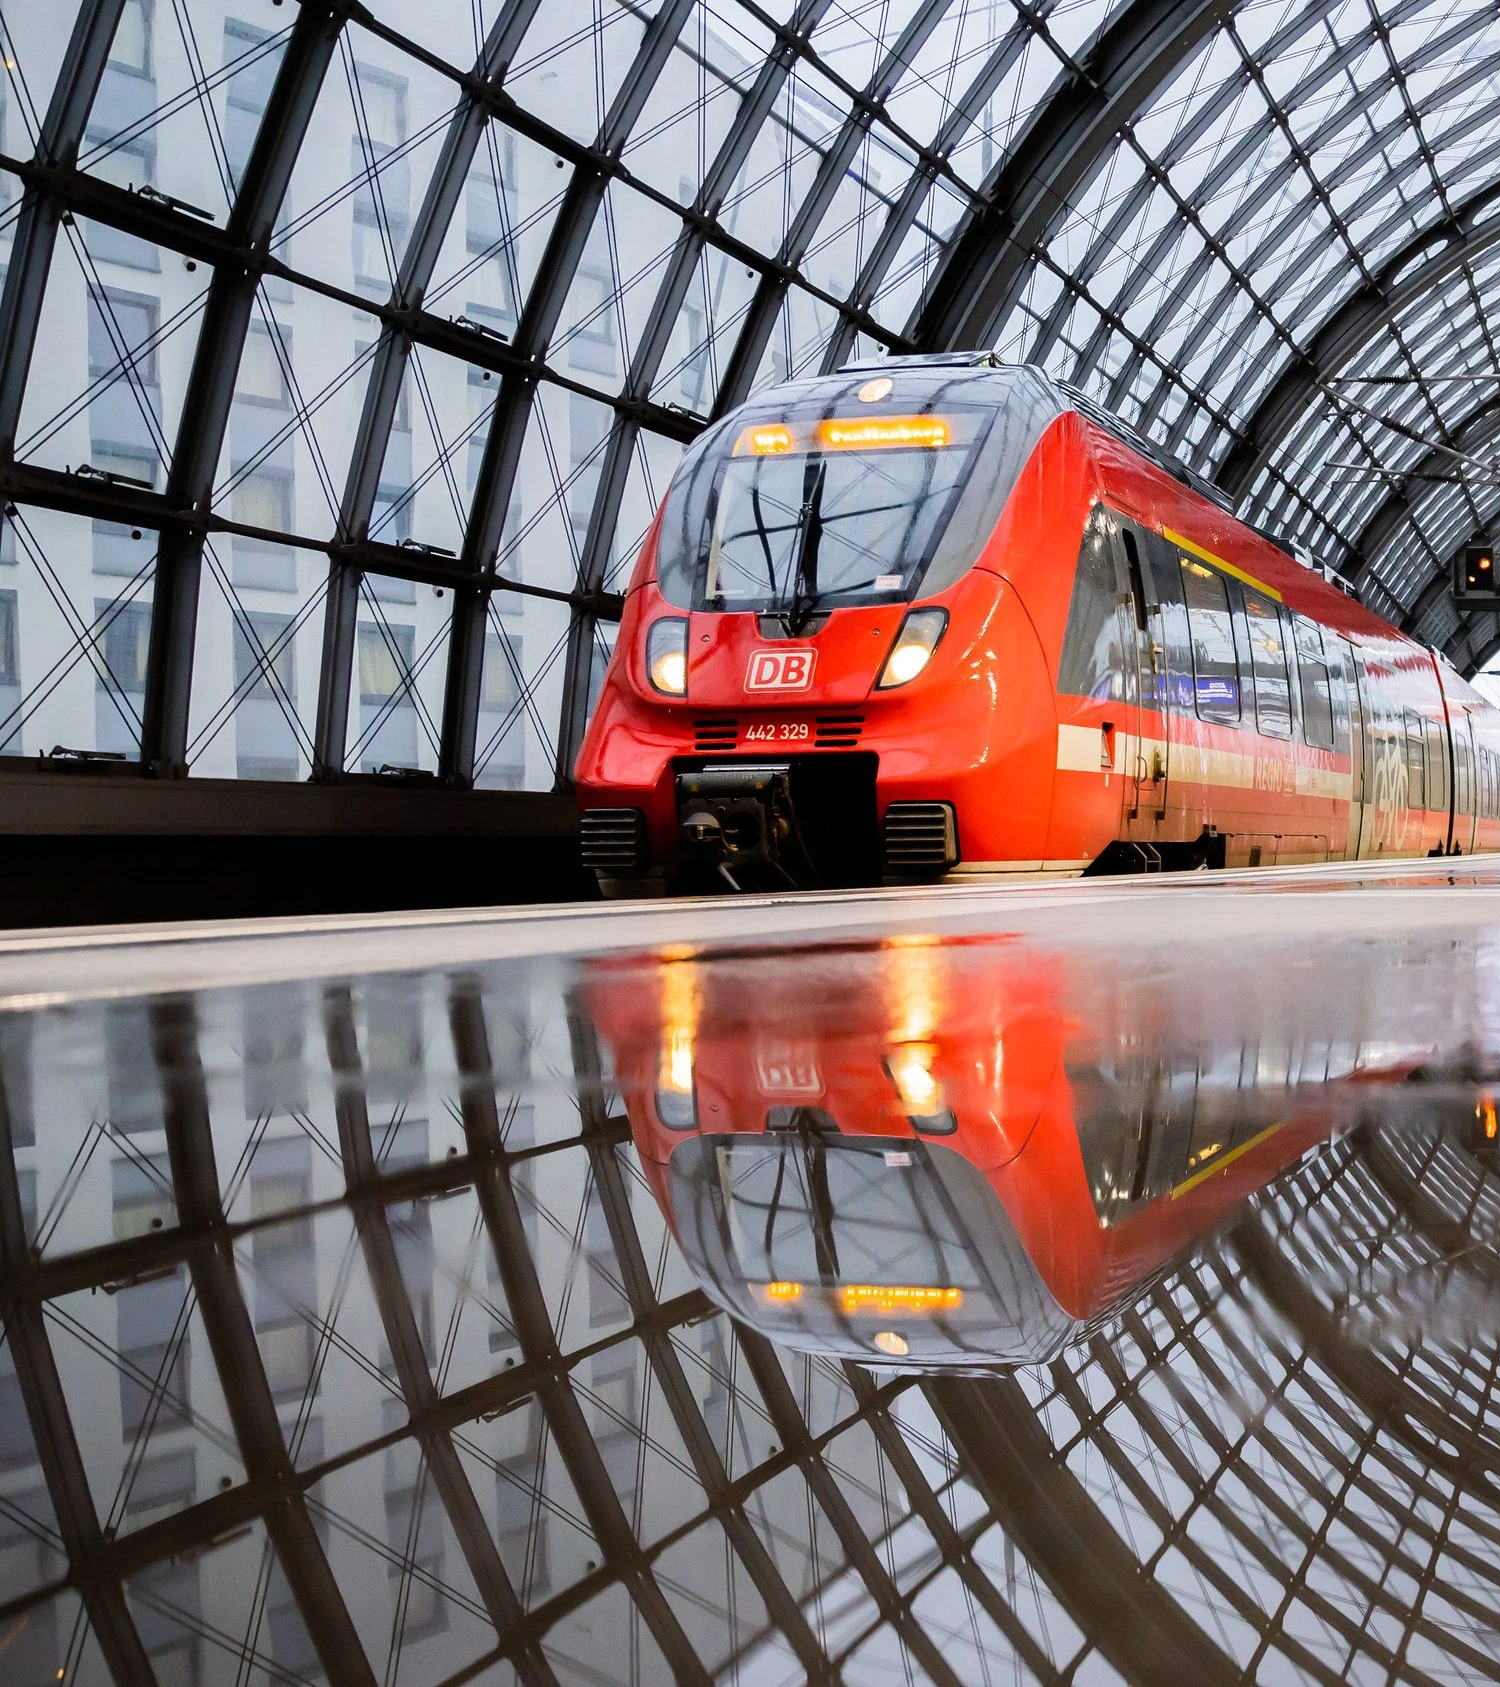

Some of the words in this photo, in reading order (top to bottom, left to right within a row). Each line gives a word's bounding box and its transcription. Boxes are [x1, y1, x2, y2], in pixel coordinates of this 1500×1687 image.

[754, 656, 807, 686] DB
[745, 724, 776, 741] 442
[779, 723, 809, 740] 329
